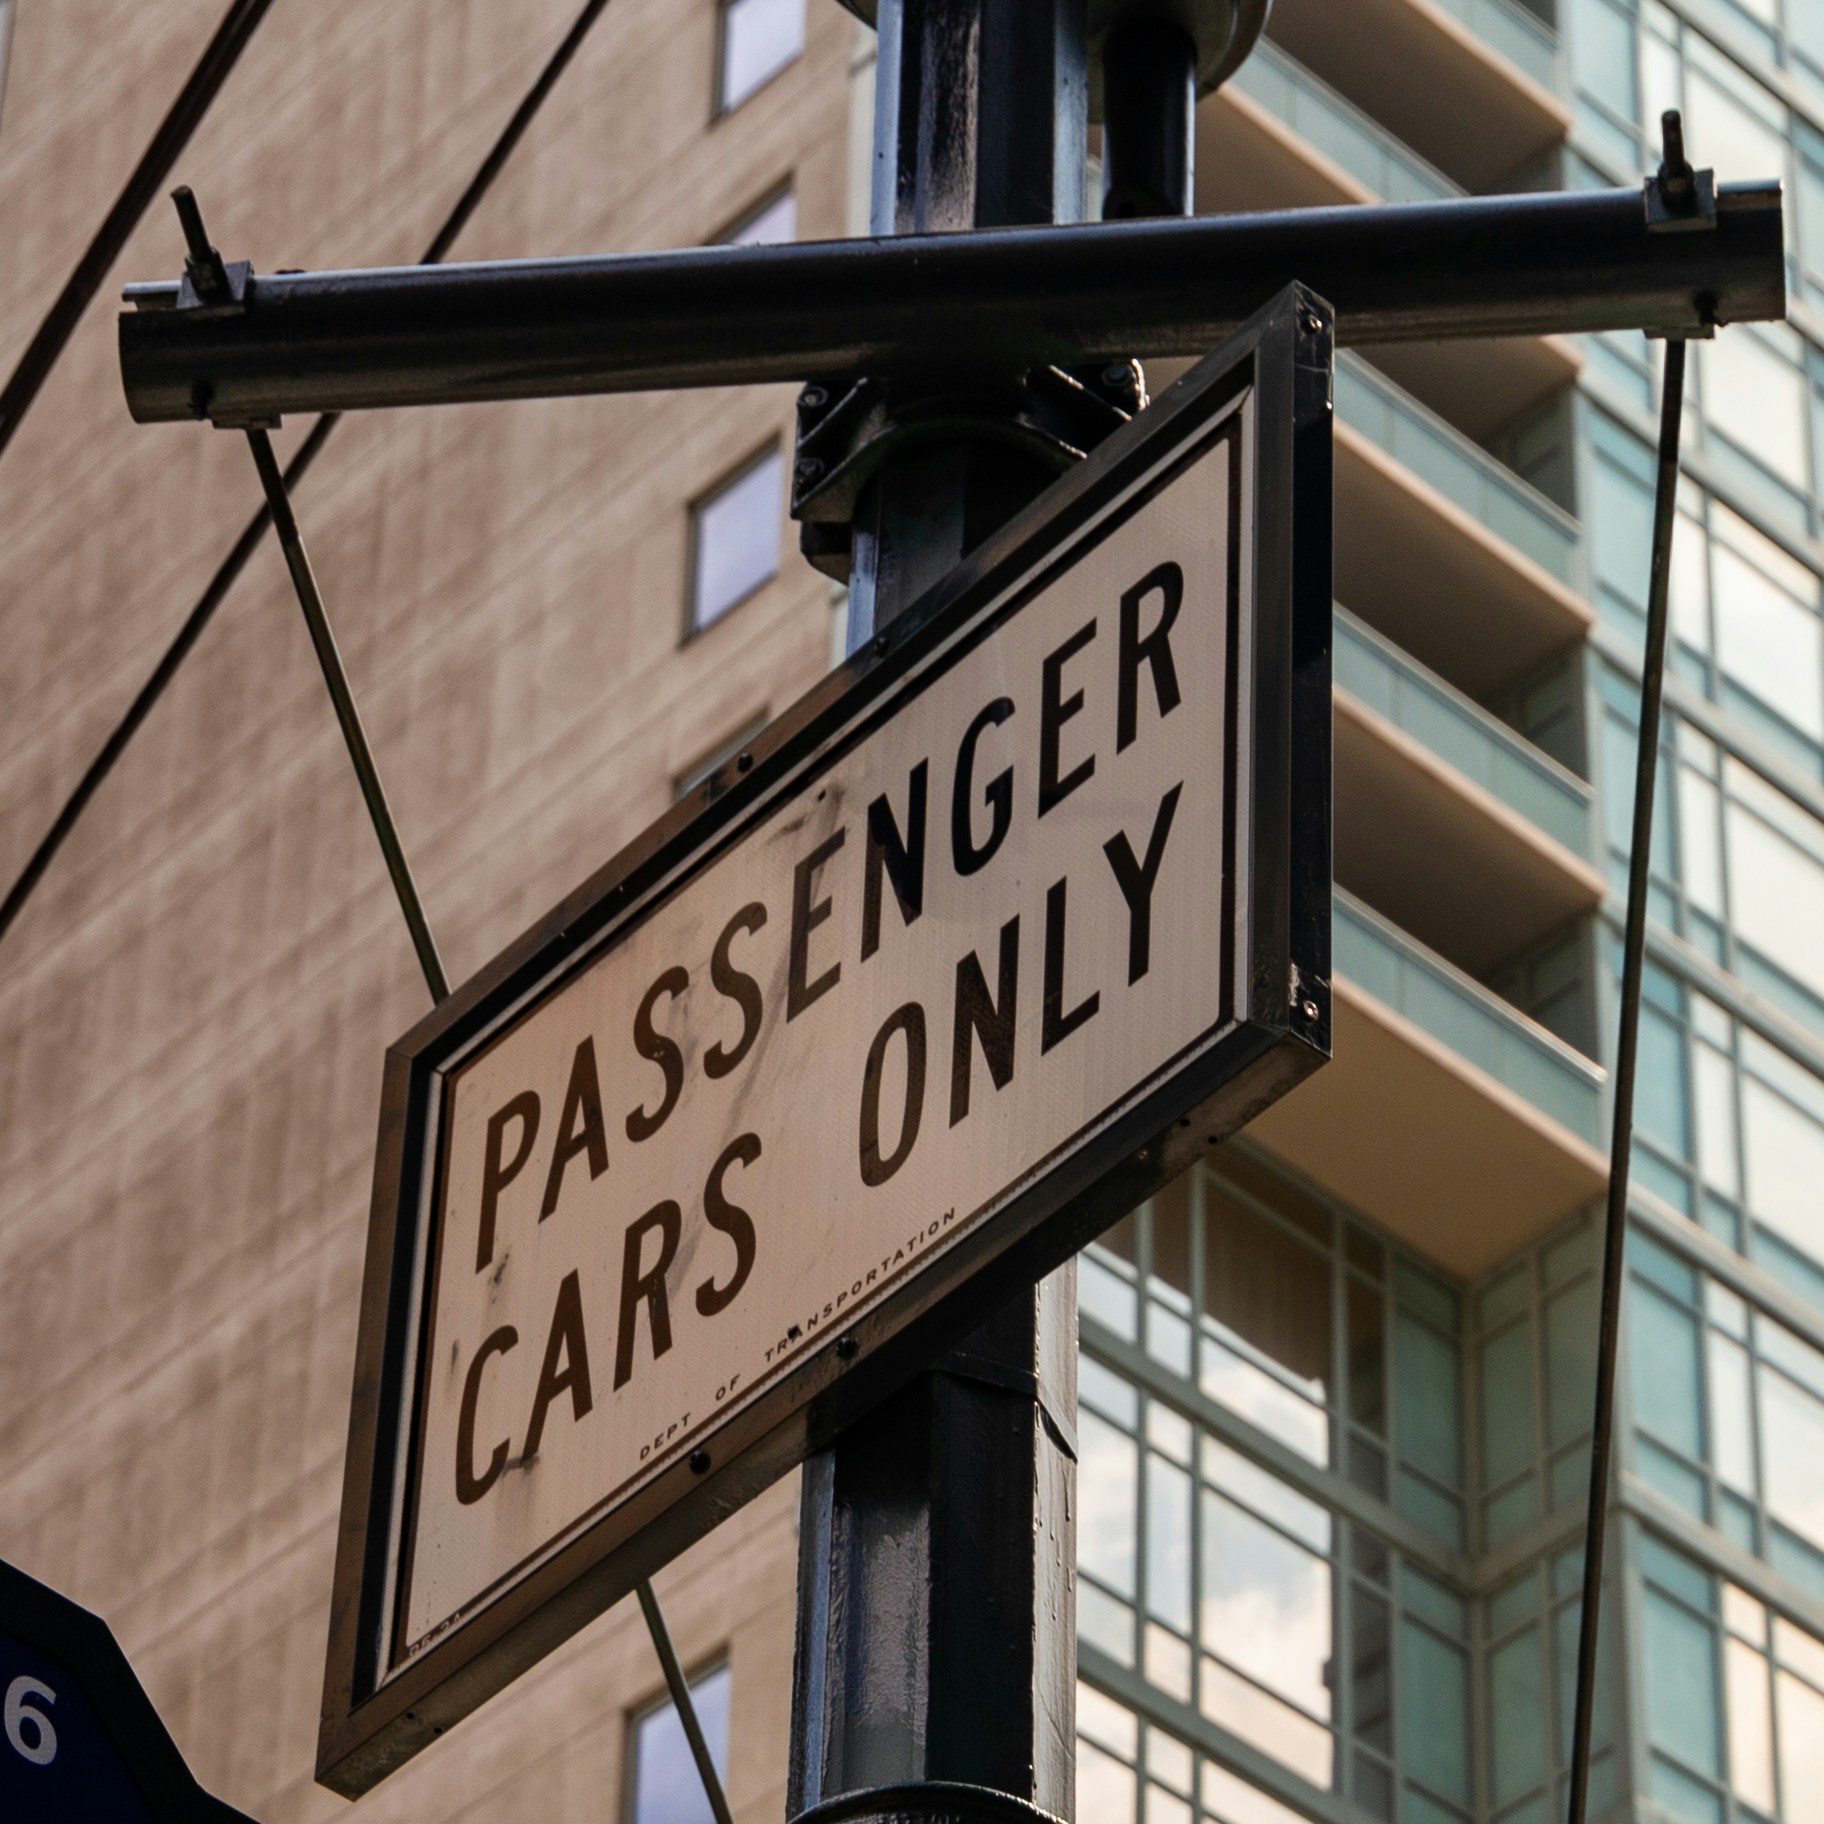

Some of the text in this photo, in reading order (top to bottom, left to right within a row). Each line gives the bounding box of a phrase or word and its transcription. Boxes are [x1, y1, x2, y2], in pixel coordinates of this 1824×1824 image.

[455, 780, 1184, 1506] CARS ONLY
[475, 560, 1184, 1274] PASSENGER
[639, 1206, 956, 1461] DEPT OF TRANSPORTATION
